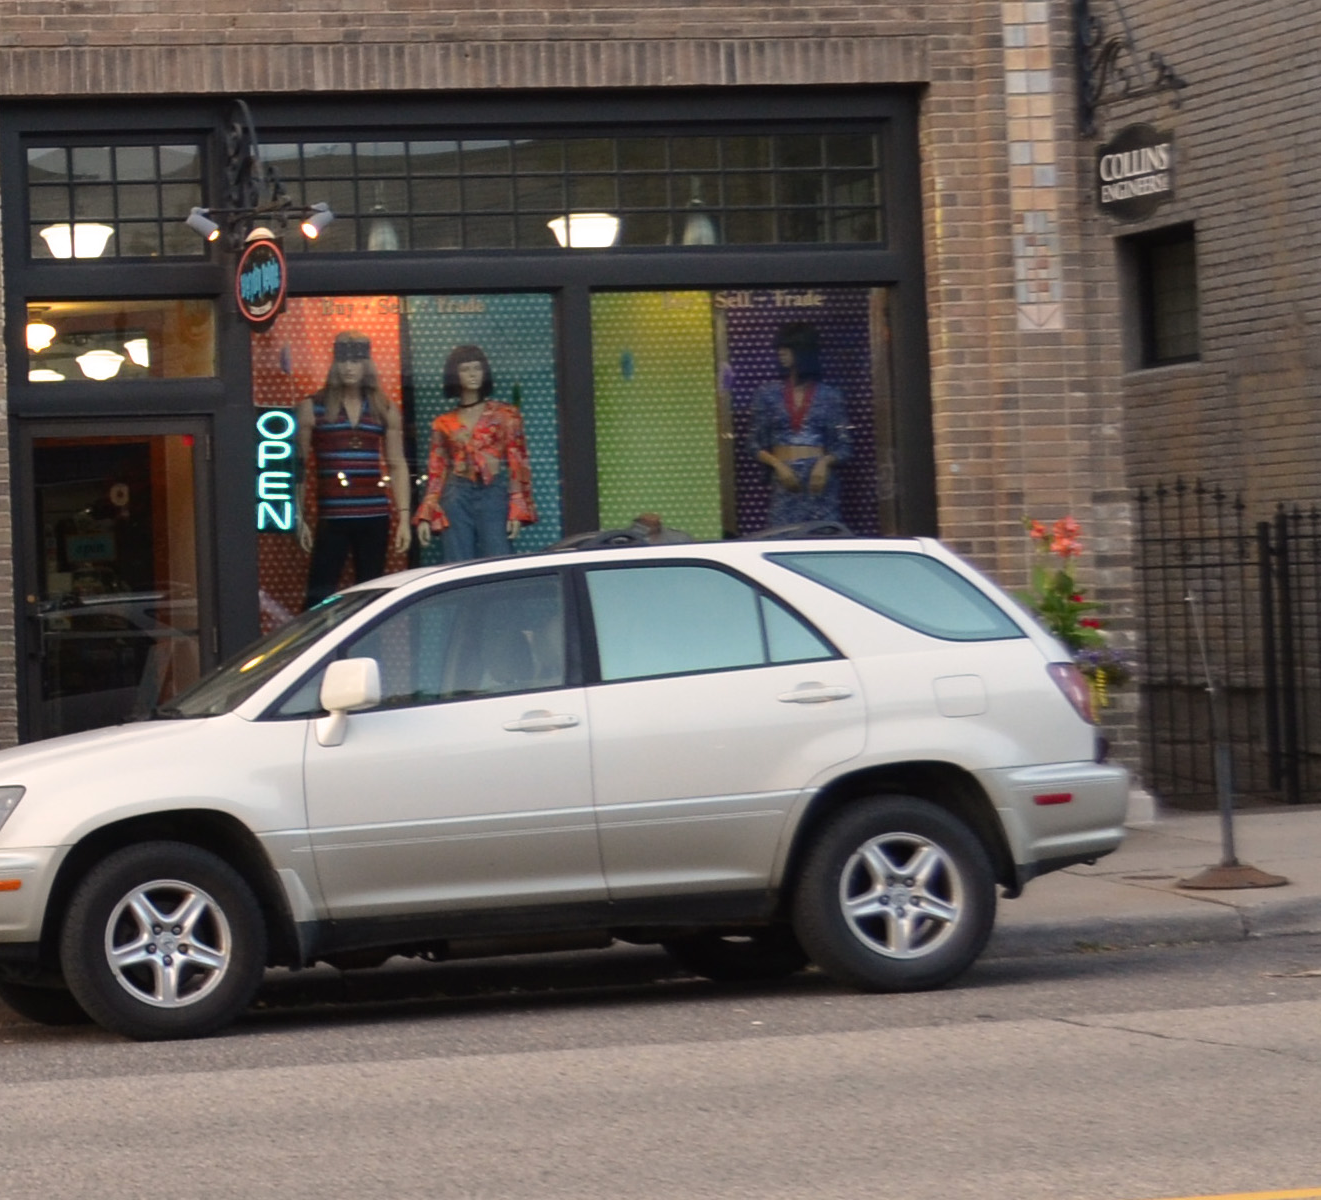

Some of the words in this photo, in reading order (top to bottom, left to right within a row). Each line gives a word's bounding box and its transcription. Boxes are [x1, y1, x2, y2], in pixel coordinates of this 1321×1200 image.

[1100, 143, 1171, 182] COLLINS
[772, 290, 824, 308] Trade
[255, 408, 296, 532] OPEN
